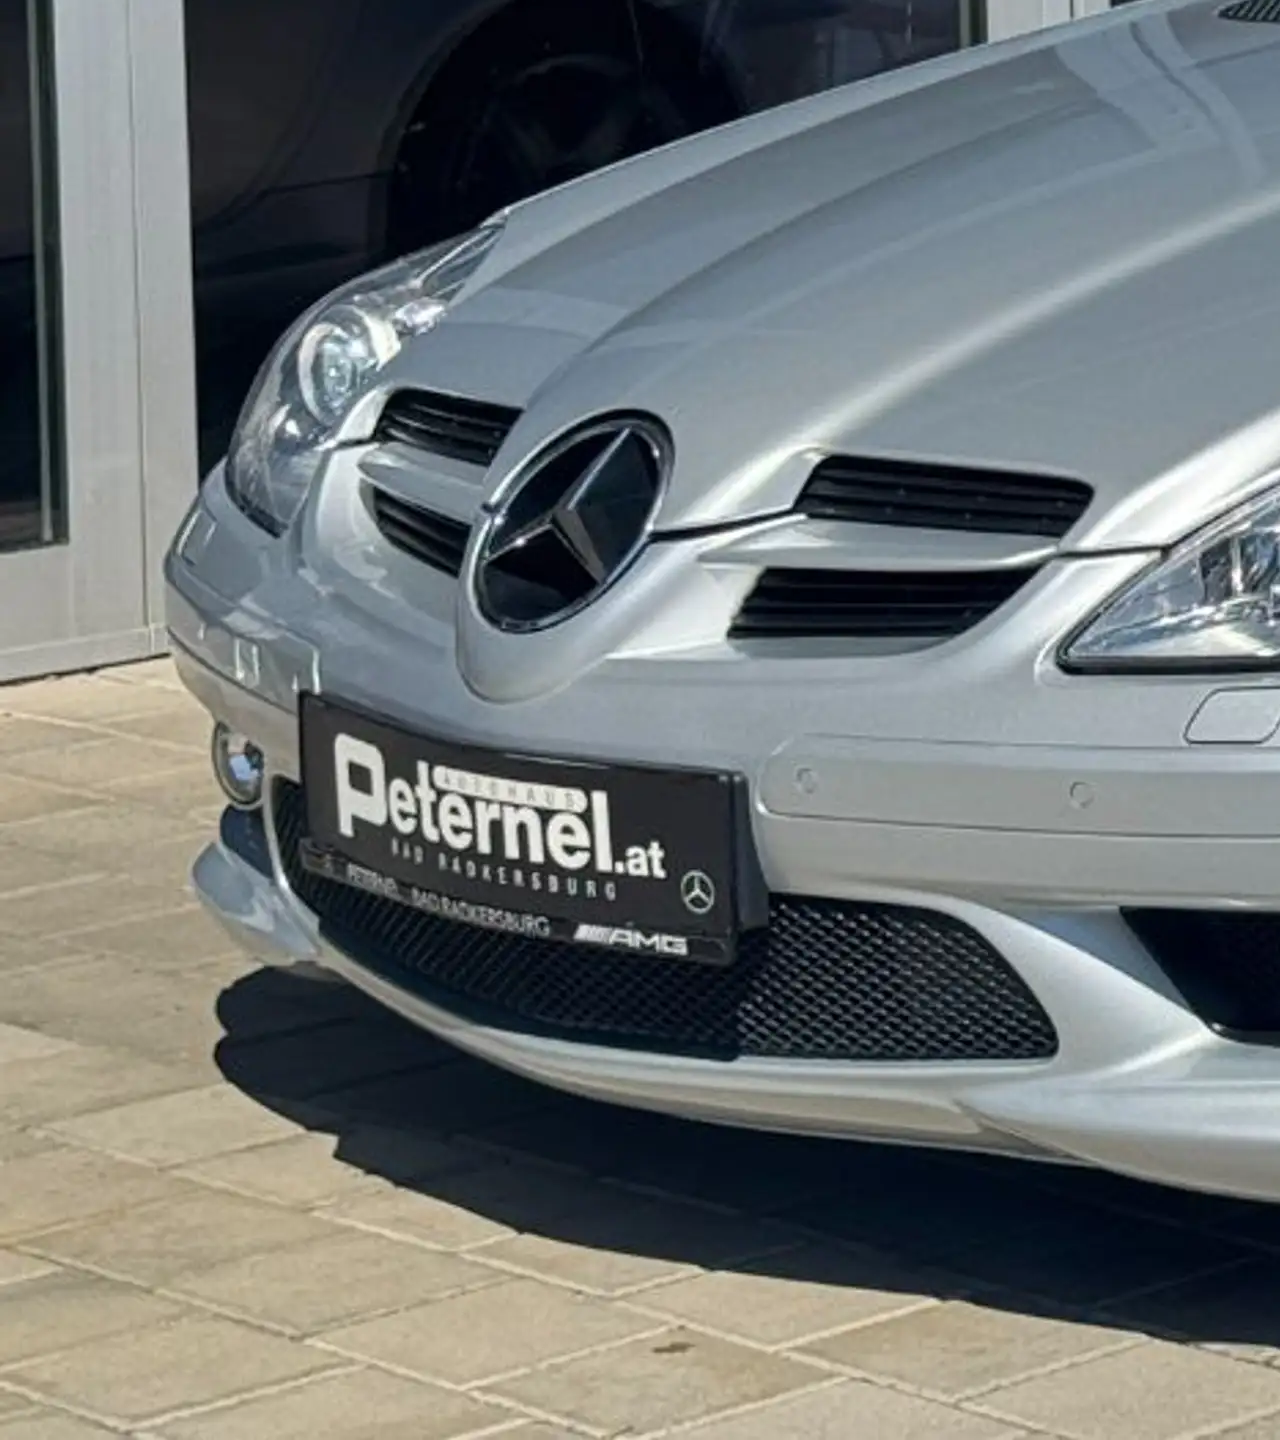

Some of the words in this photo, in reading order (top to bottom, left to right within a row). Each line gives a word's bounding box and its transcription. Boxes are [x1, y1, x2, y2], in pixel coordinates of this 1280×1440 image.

[443, 771, 576, 809] AUTOHAUS
[391, 837, 424, 866] BAD
[438, 852, 617, 902] RADKERSBURG
[611, 926, 689, 957] AMG
